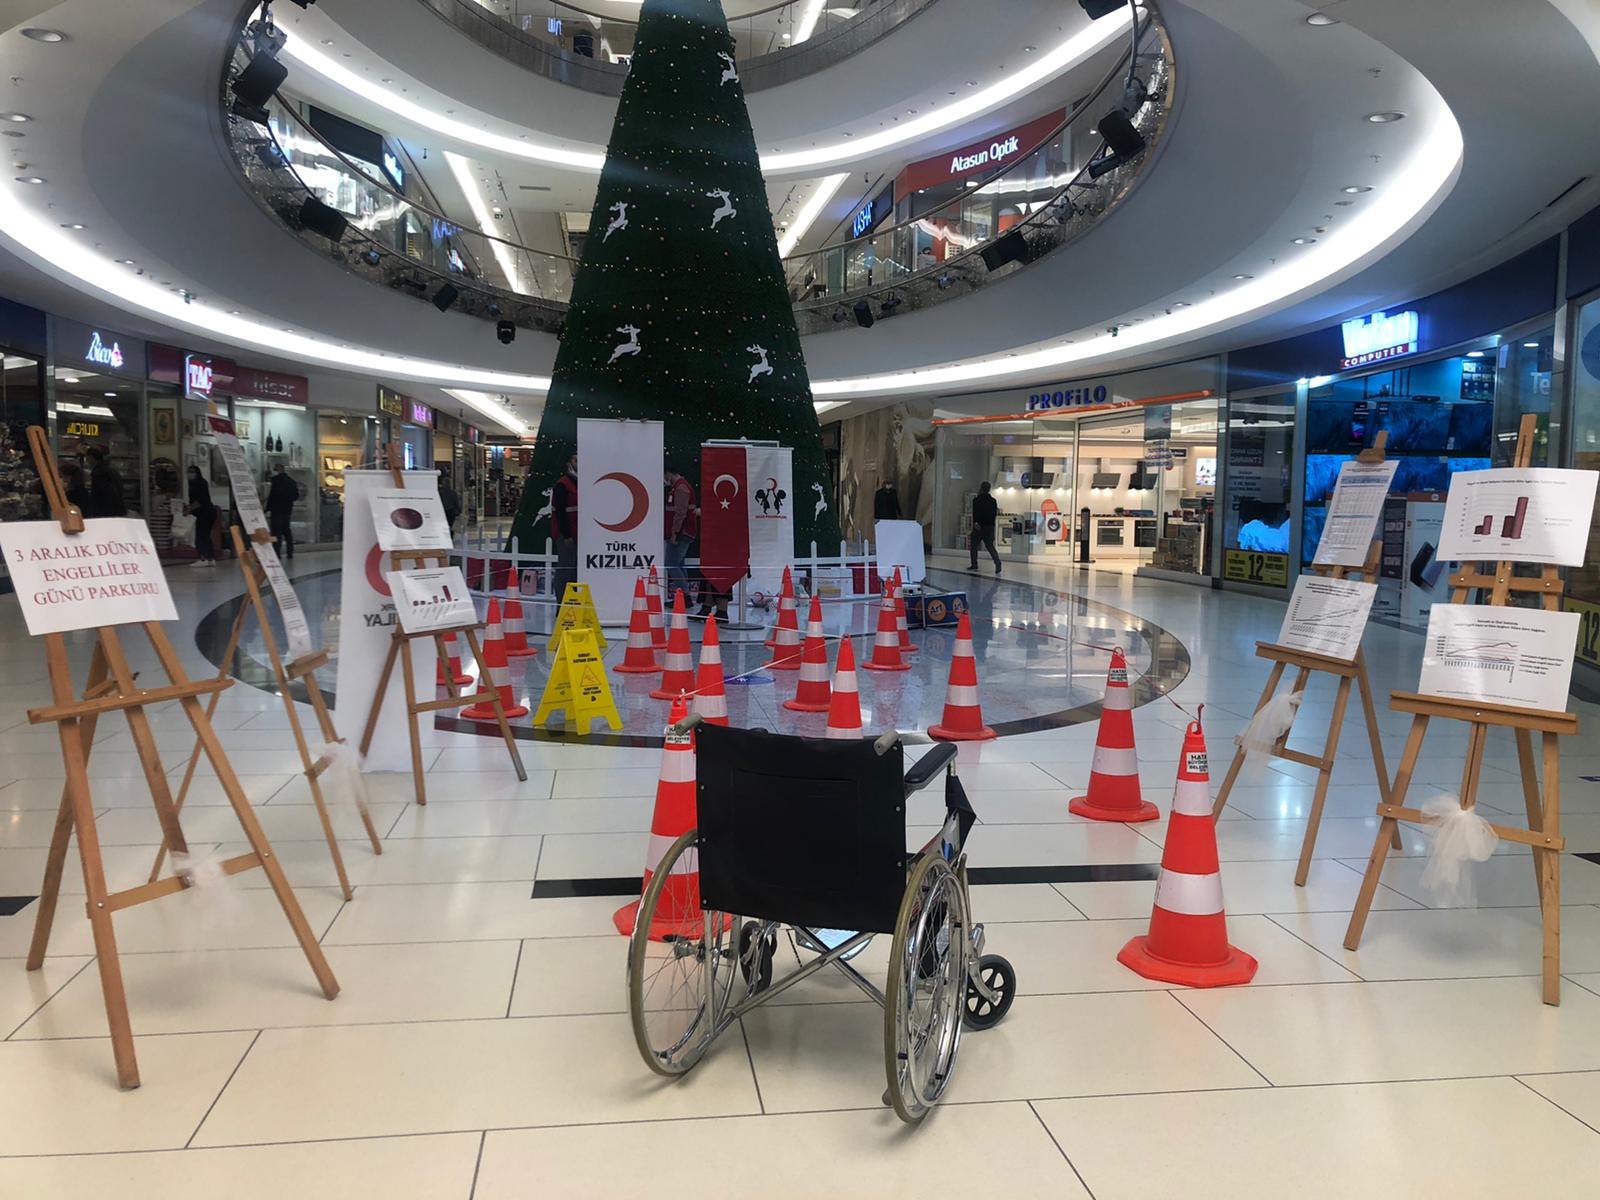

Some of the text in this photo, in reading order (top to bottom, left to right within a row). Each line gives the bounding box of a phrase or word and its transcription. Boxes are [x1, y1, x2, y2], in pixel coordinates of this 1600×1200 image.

[951, 136, 1019, 173] Atasun Optik
[1344, 346, 1404, 367] COMPUTER
[1028, 385, 1108, 411] PROFiLO
[15, 541, 149, 562] 3 ARALIK DÜNYA
[605, 541, 637, 552] TÜRK
[42, 562, 143, 582] ENGELLİLER
[586, 554, 655, 570] KIZILAY
[1248, 554, 1264, 581] 12
[34, 582, 160, 606] GÜNÜ PARKURU
